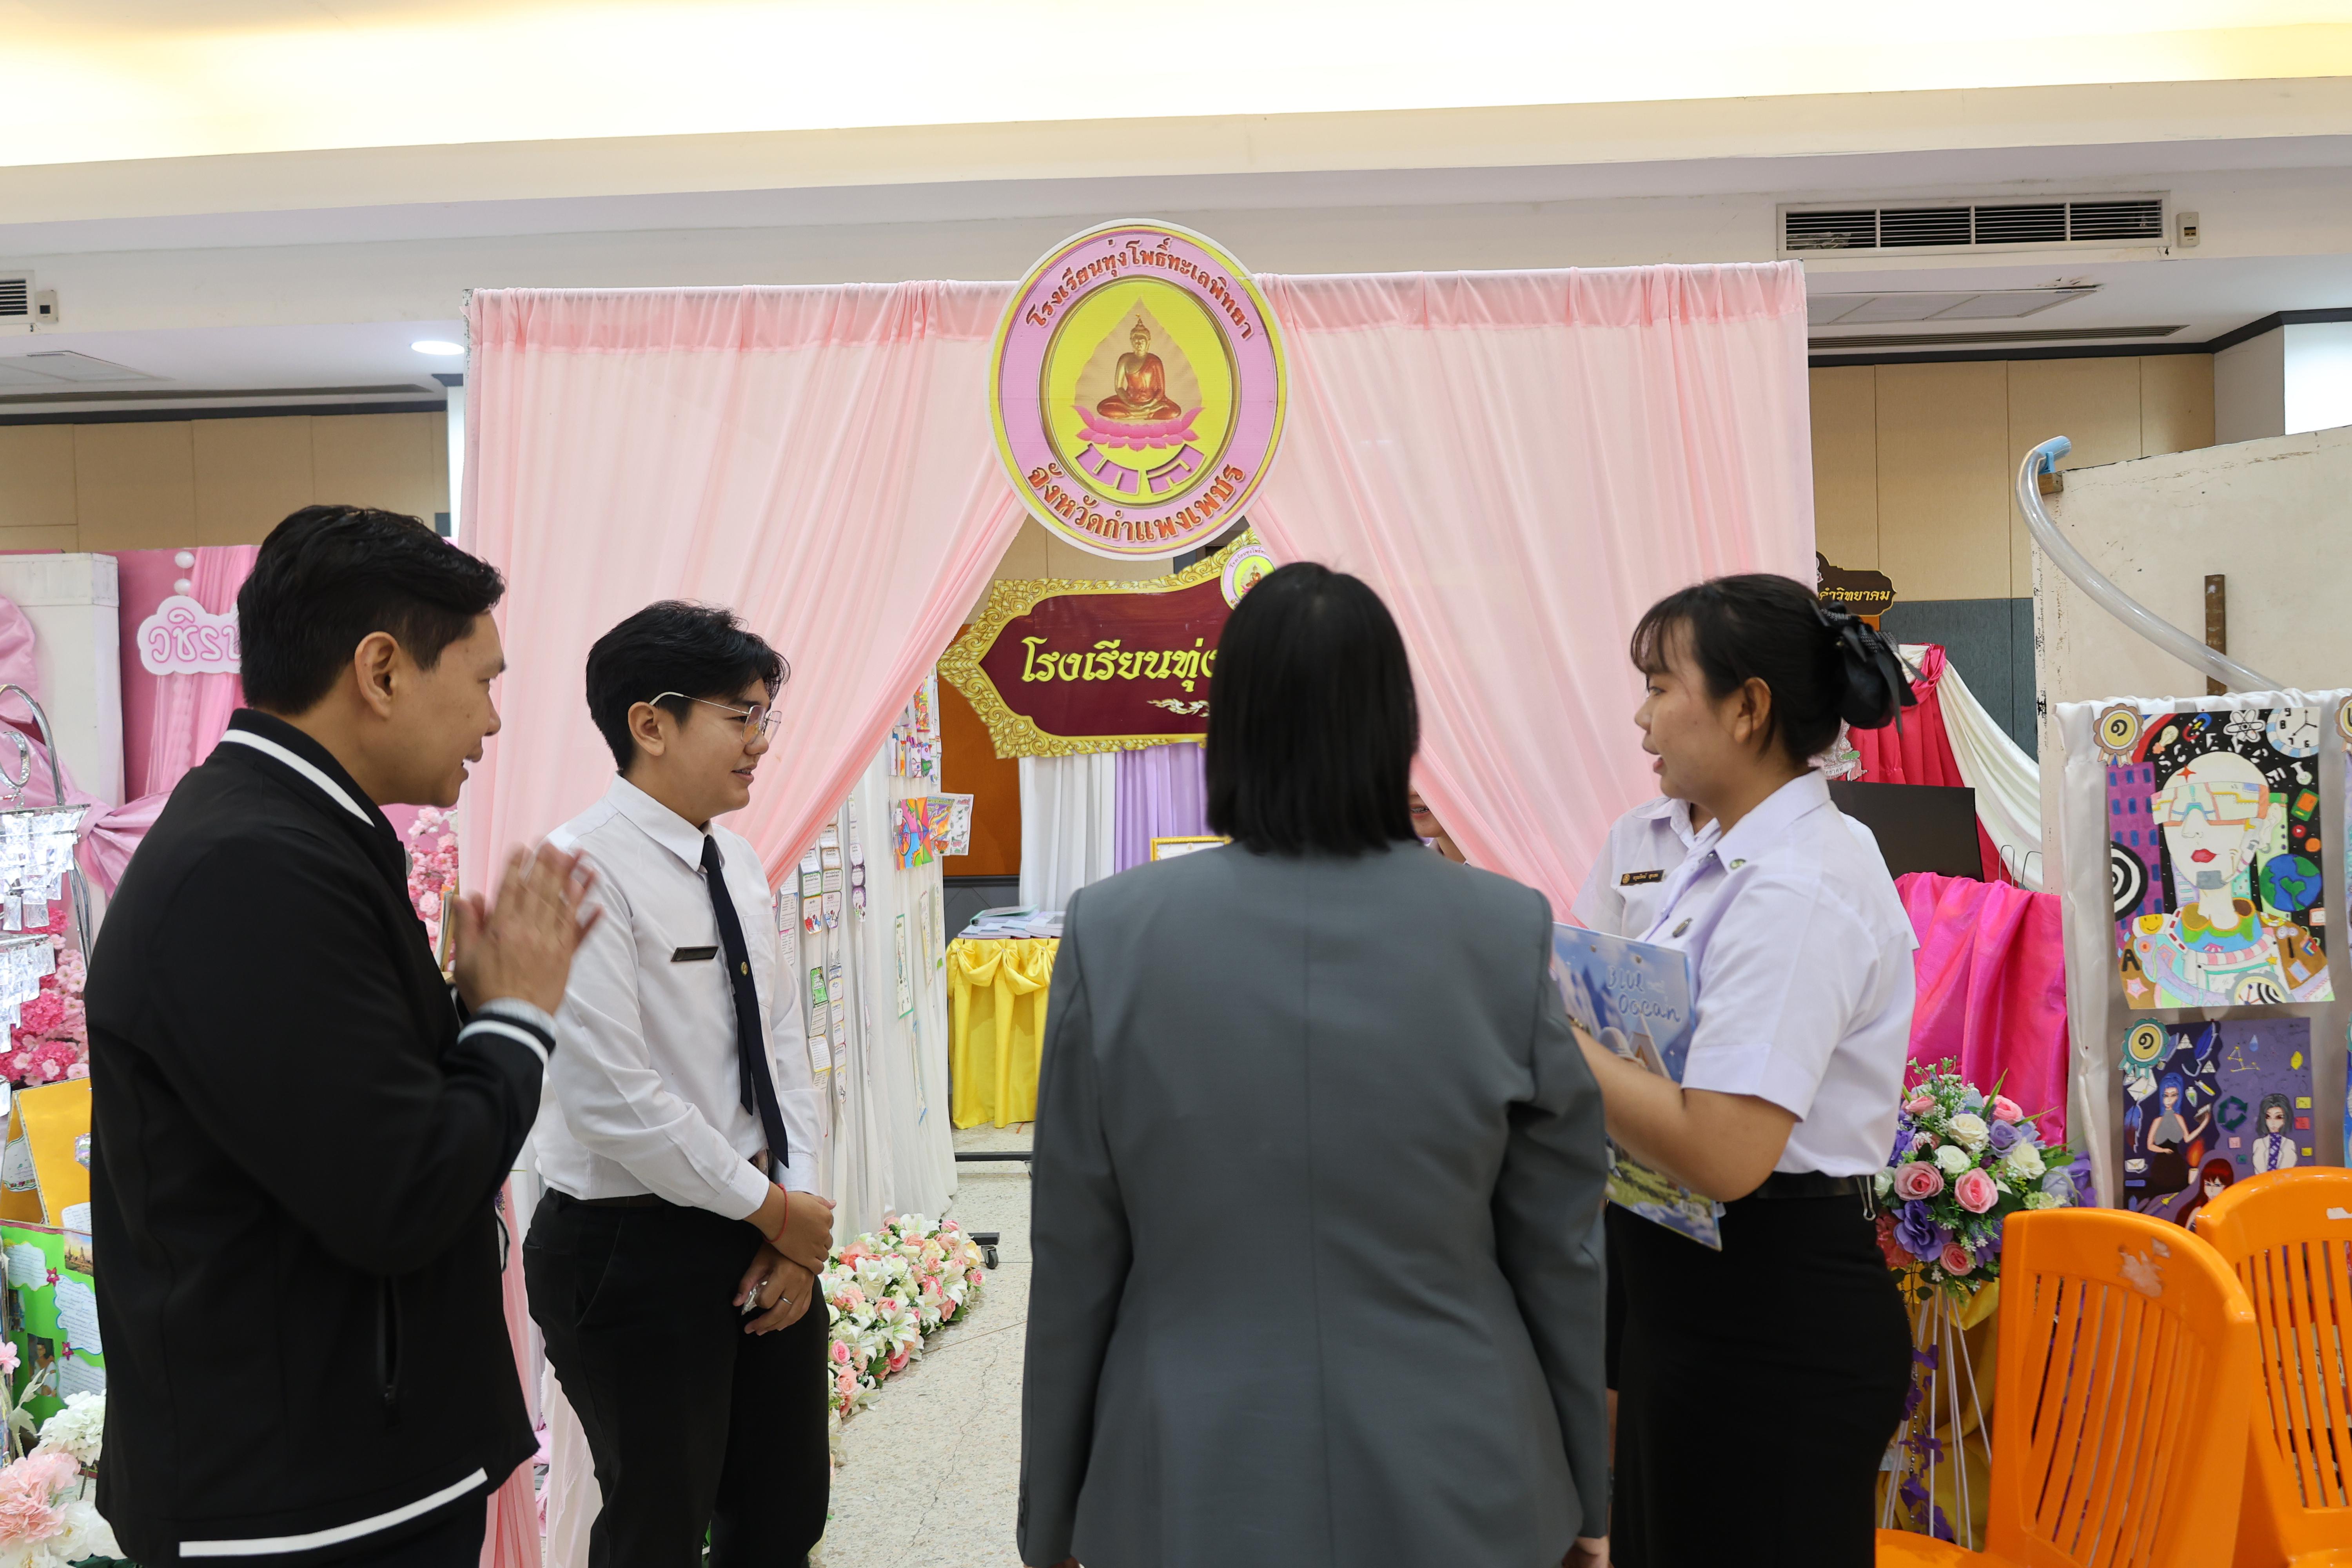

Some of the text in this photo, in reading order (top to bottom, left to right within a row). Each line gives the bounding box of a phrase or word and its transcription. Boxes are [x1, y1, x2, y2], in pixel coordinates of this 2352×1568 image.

[1026, 238, 1254, 339] โรงเรียนทุ่งโพธิ์ทะเลพิทยา
[1027, 463, 1245, 541] จังหวัดกำแพงเพชร
[1021, 637, 1218, 692] โรงเรียนทุ่ง
[2122, 949, 2141, 972] A
